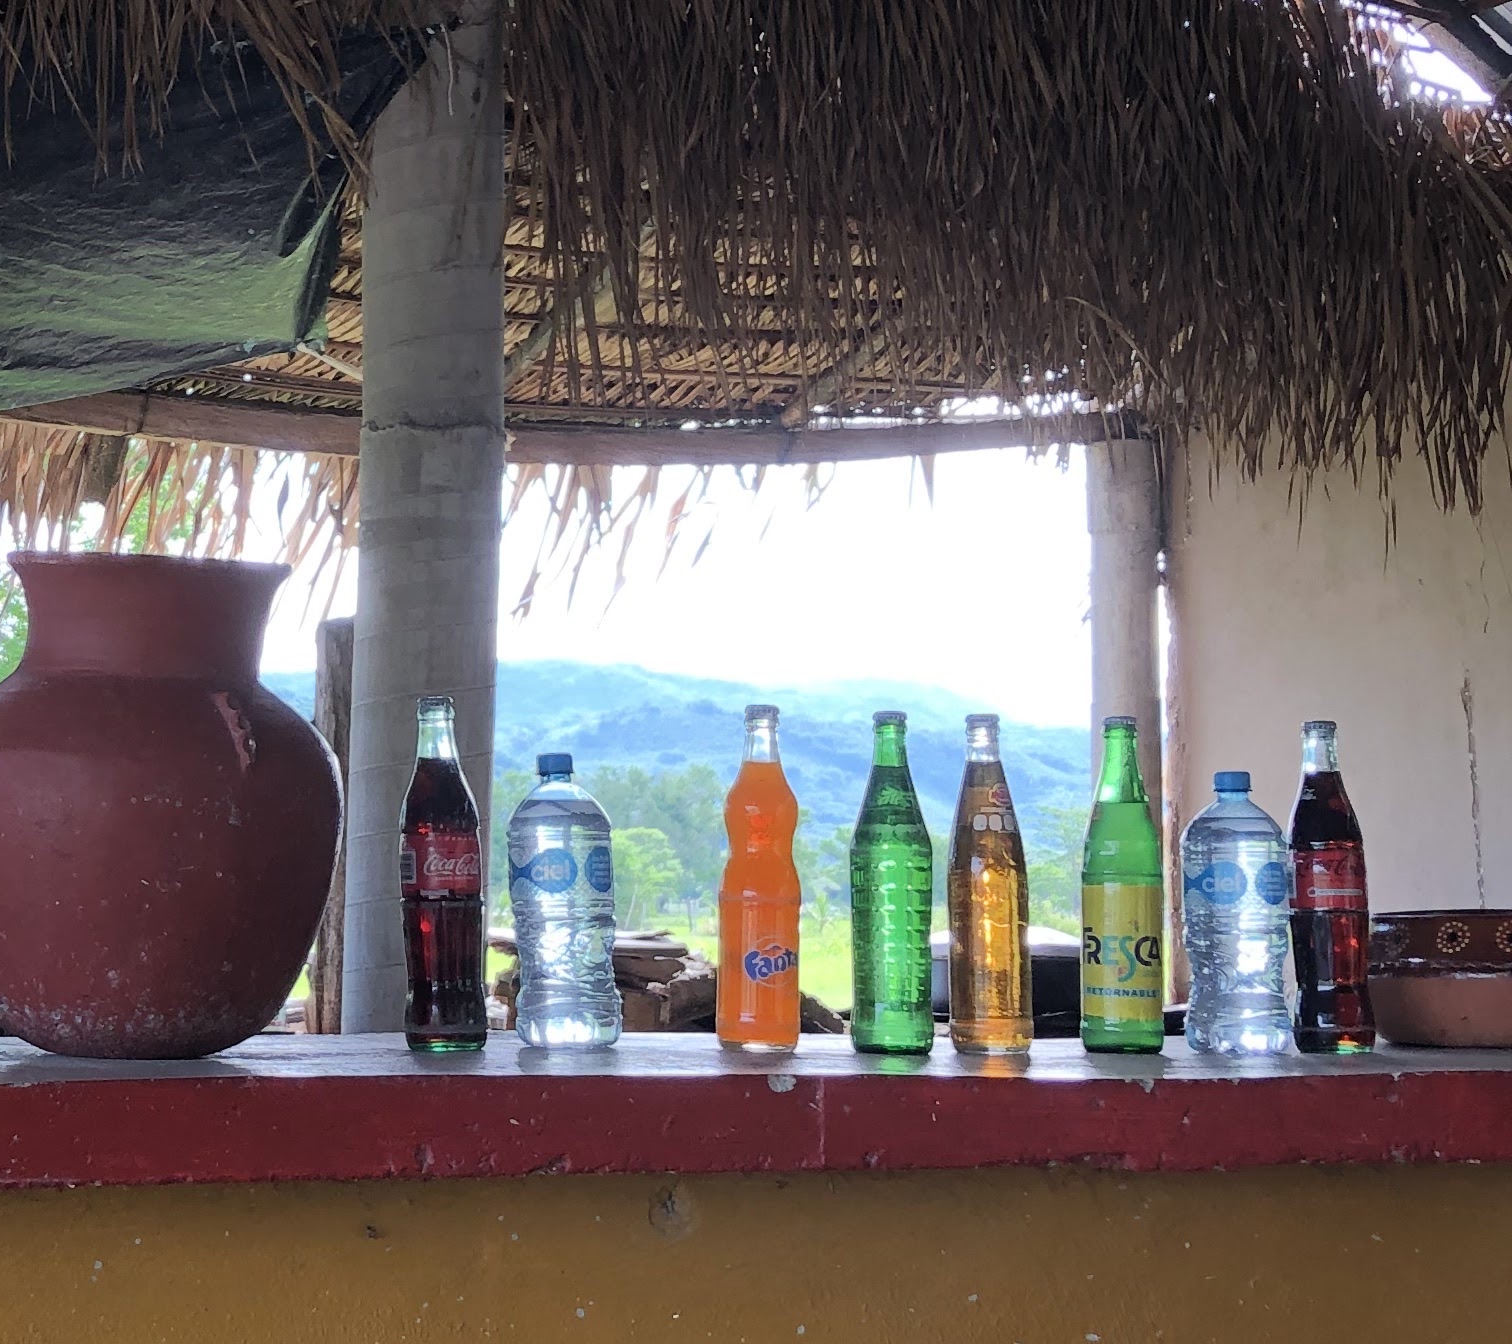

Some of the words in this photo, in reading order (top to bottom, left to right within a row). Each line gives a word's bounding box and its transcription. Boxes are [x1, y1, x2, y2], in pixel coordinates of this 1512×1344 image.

[530, 857, 570, 882] ciel
[1202, 870, 1242, 893] ciel
[1083, 927, 1162, 983] FRESCA
